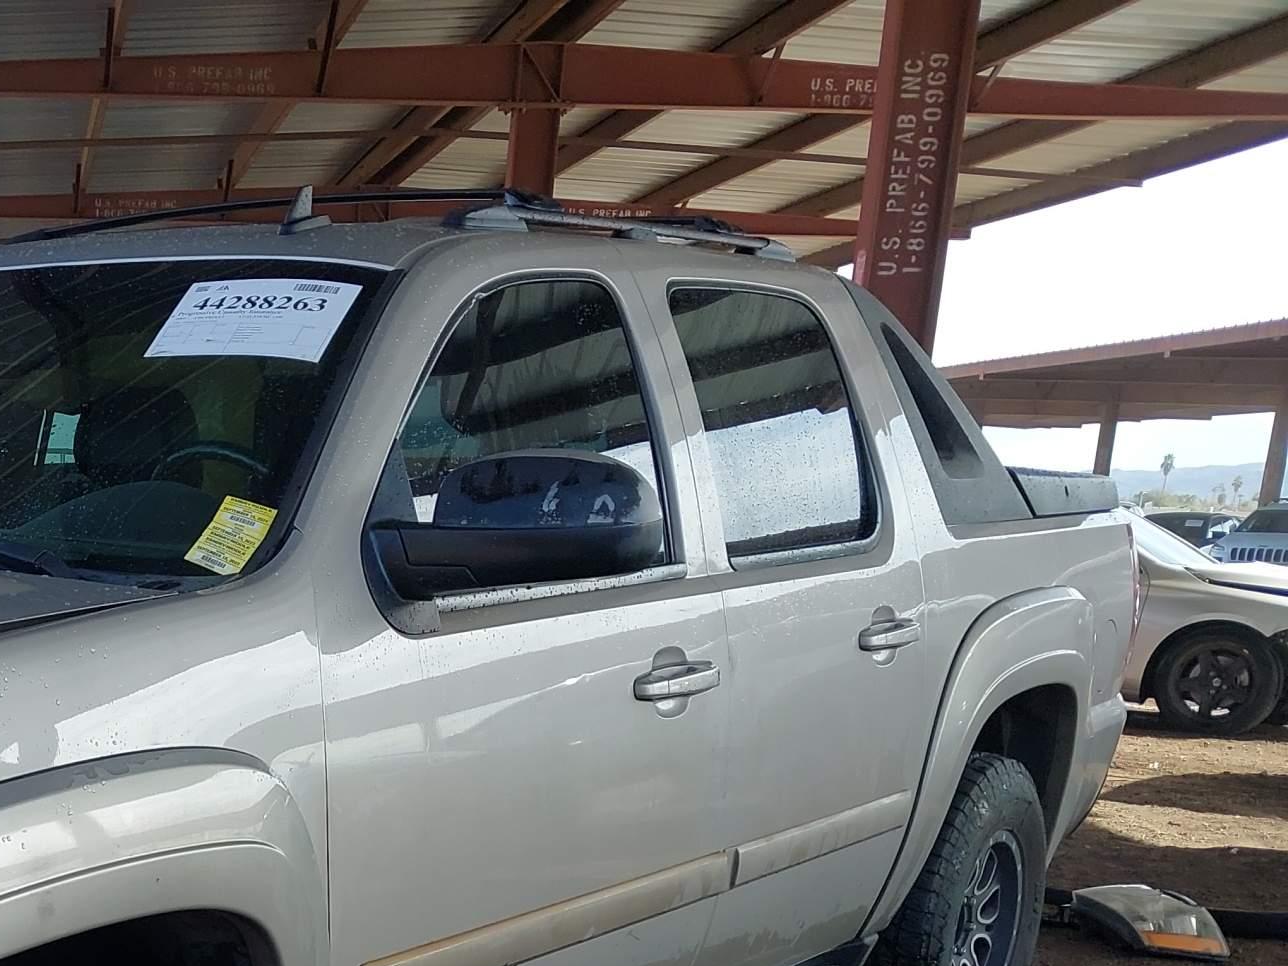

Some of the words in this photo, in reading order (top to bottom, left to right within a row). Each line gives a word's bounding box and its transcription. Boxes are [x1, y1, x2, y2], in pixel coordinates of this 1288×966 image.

[811, 78, 838, 92] U.S.
[886, 114, 917, 212] PREFAB
[902, 52, 950, 274] 1-866-799-0969
[877, 228, 902, 276] U.S.
[192, 294, 329, 313] 44288263
